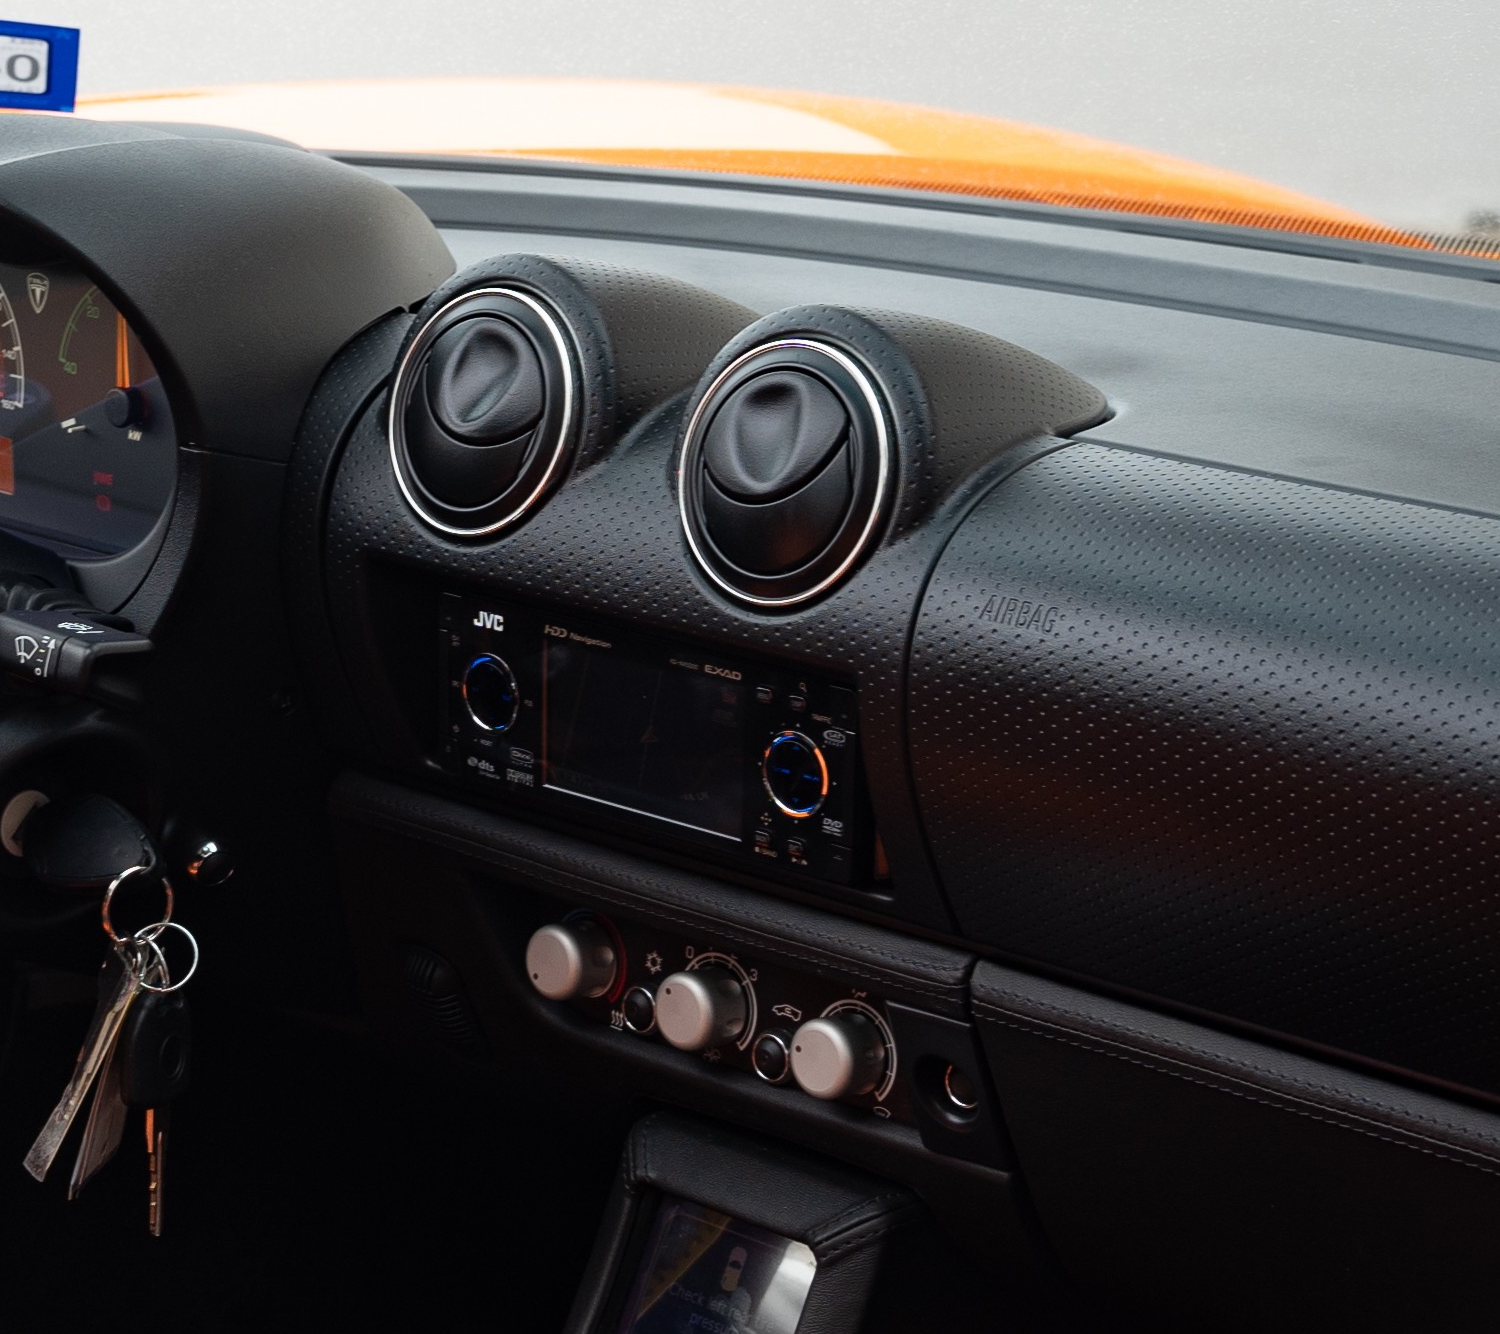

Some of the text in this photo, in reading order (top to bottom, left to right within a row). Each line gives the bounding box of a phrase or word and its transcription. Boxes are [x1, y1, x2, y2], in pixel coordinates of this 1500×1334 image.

[87, 306, 99, 319] 20
[64, 361, 77, 375] 40
[473, 610, 505, 632] JVC
[978, 594, 1059, 634] AIRBAG
[544, 624, 613, 650] HDD Navigation
[704, 664, 742, 681] EXAD
[823, 817, 843, 828] DVD
[749, 968, 758, 982] 3
[668, 1283, 704, 1308] Check
